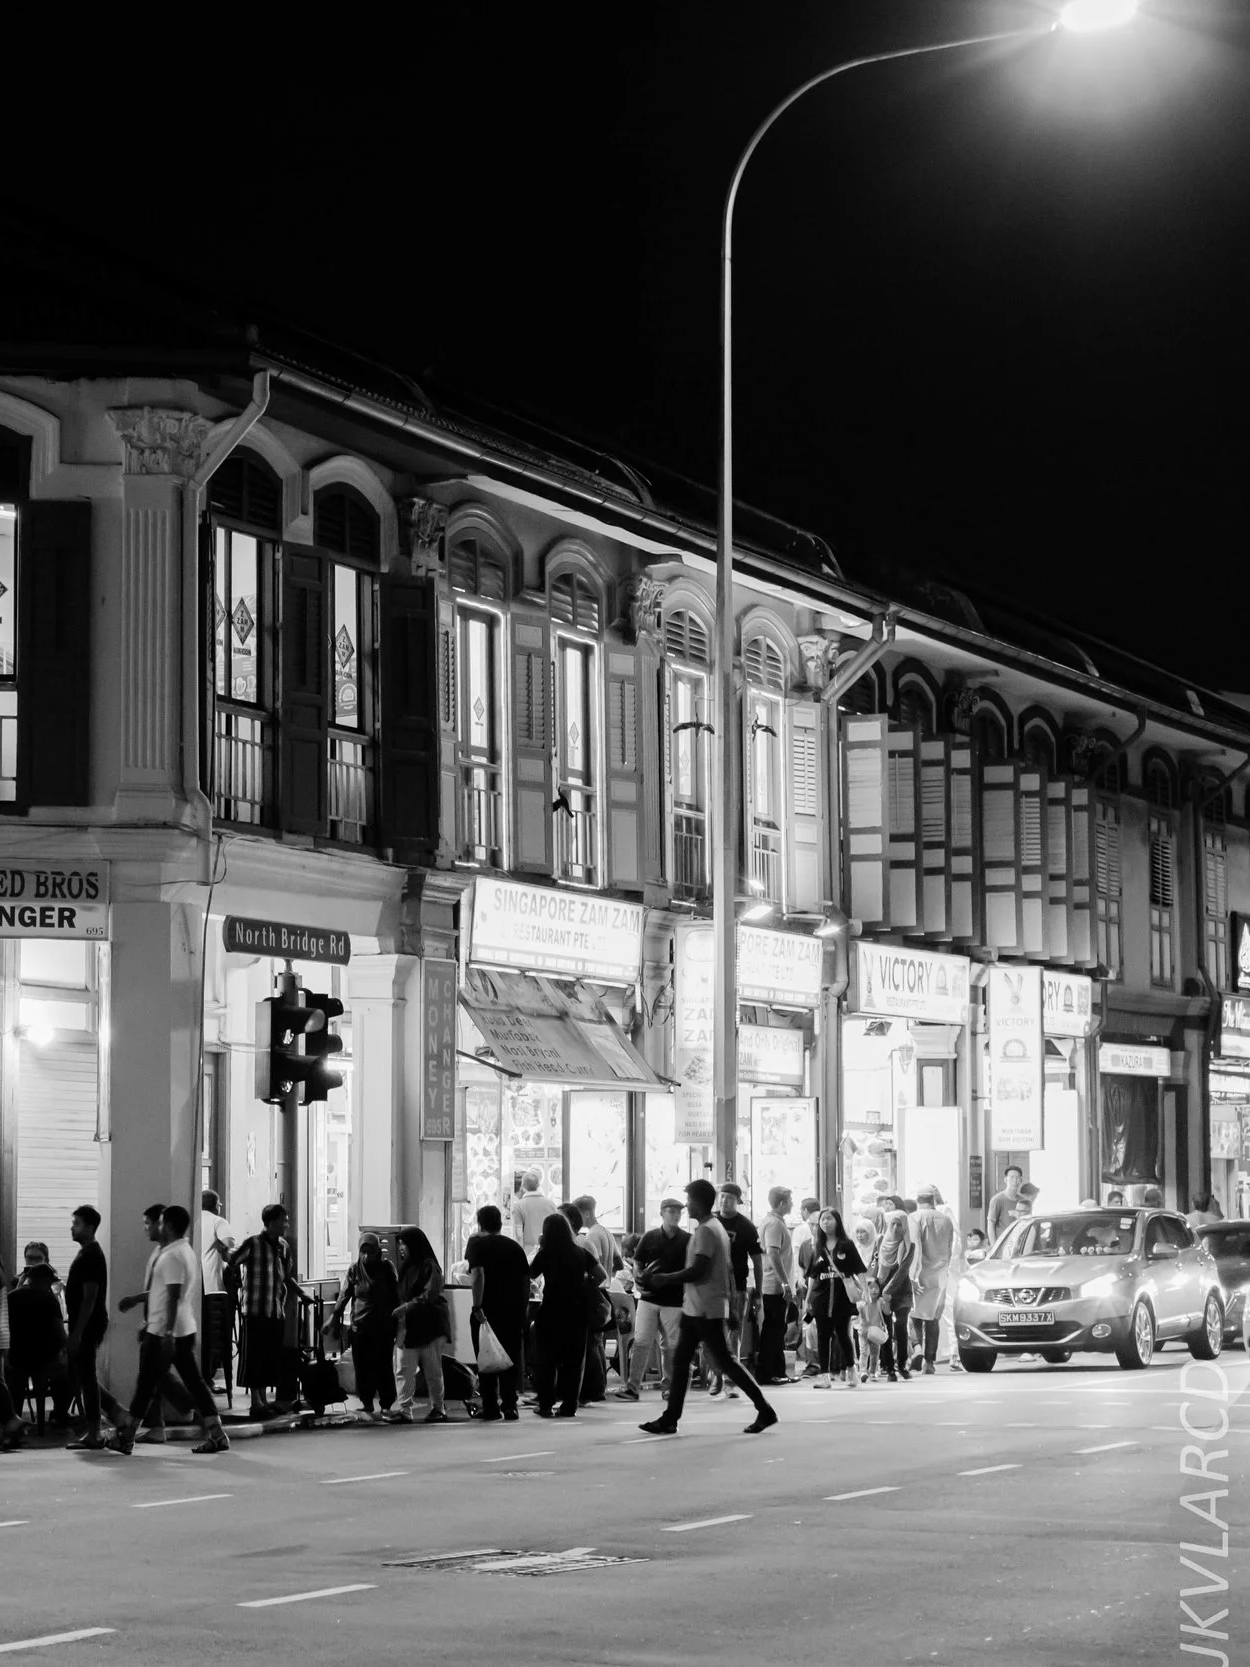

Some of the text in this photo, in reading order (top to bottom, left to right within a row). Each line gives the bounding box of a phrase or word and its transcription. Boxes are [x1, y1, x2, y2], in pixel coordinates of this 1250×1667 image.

[34, 871, 99, 900] BROS
[494, 888, 640, 933] SINGAPORE ZAM ZAM
[86, 927, 104, 936] 695
[235, 922, 345, 958] North Bridge Rd
[574, 931, 590, 950] PTE
[772, 937, 795, 960] ZAM
[798, 942, 820, 964] ZAM
[880, 955, 932, 994] VICTORY
[996, 1017, 1035, 1027] VICTORY
[428, 978, 438, 1109] MONEY
[442, 980, 452, 1135] CHANGER
